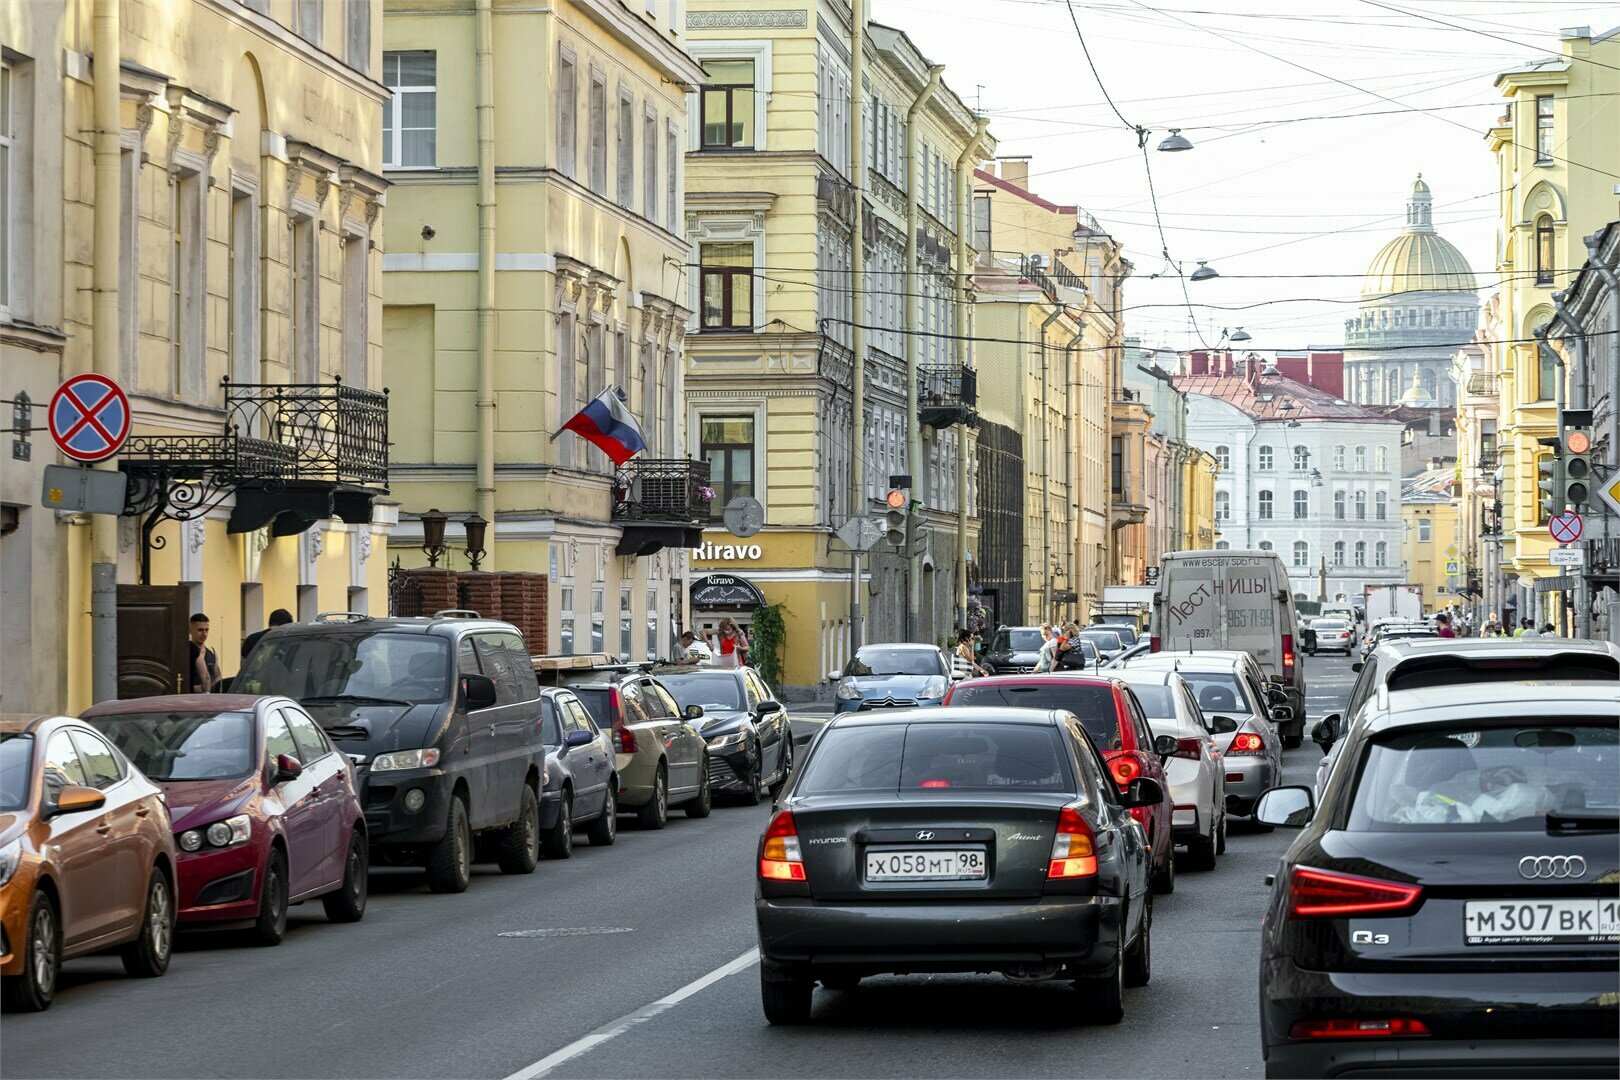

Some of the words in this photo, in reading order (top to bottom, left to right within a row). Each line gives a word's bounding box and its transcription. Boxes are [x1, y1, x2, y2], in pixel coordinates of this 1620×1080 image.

[692, 541, 762, 560] Riravo
[707, 575, 735, 585] Riravo
[809, 837, 847, 845] HYUNDAI
[1007, 832, 1044, 841] Accent
[959, 853, 978, 868] 98
[1603, 902, 1620, 923] 1
[1352, 930, 1390, 945] Q3
